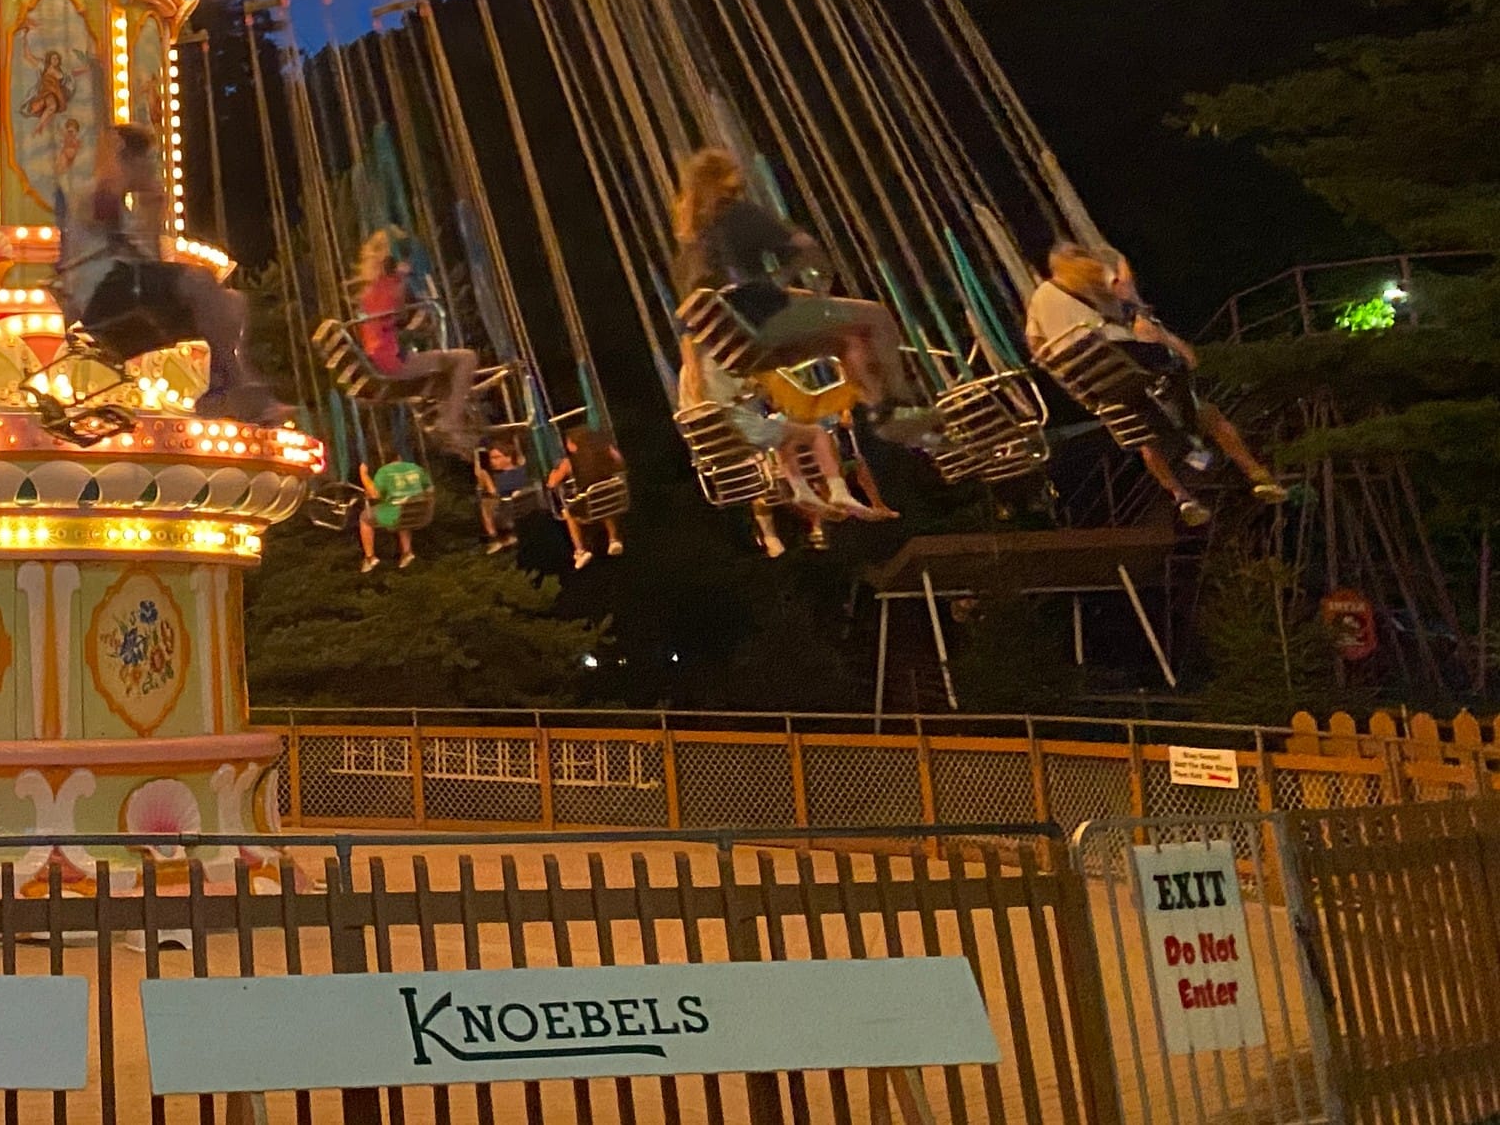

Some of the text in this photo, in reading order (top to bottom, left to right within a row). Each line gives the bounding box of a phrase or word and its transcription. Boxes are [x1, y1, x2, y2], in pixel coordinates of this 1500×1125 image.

[1153, 870, 1227, 911] EXIT
[1164, 932, 1240, 967] Do Not
[1178, 977, 1239, 1010] Enter
[398, 986, 710, 1066] KNOEBELS
